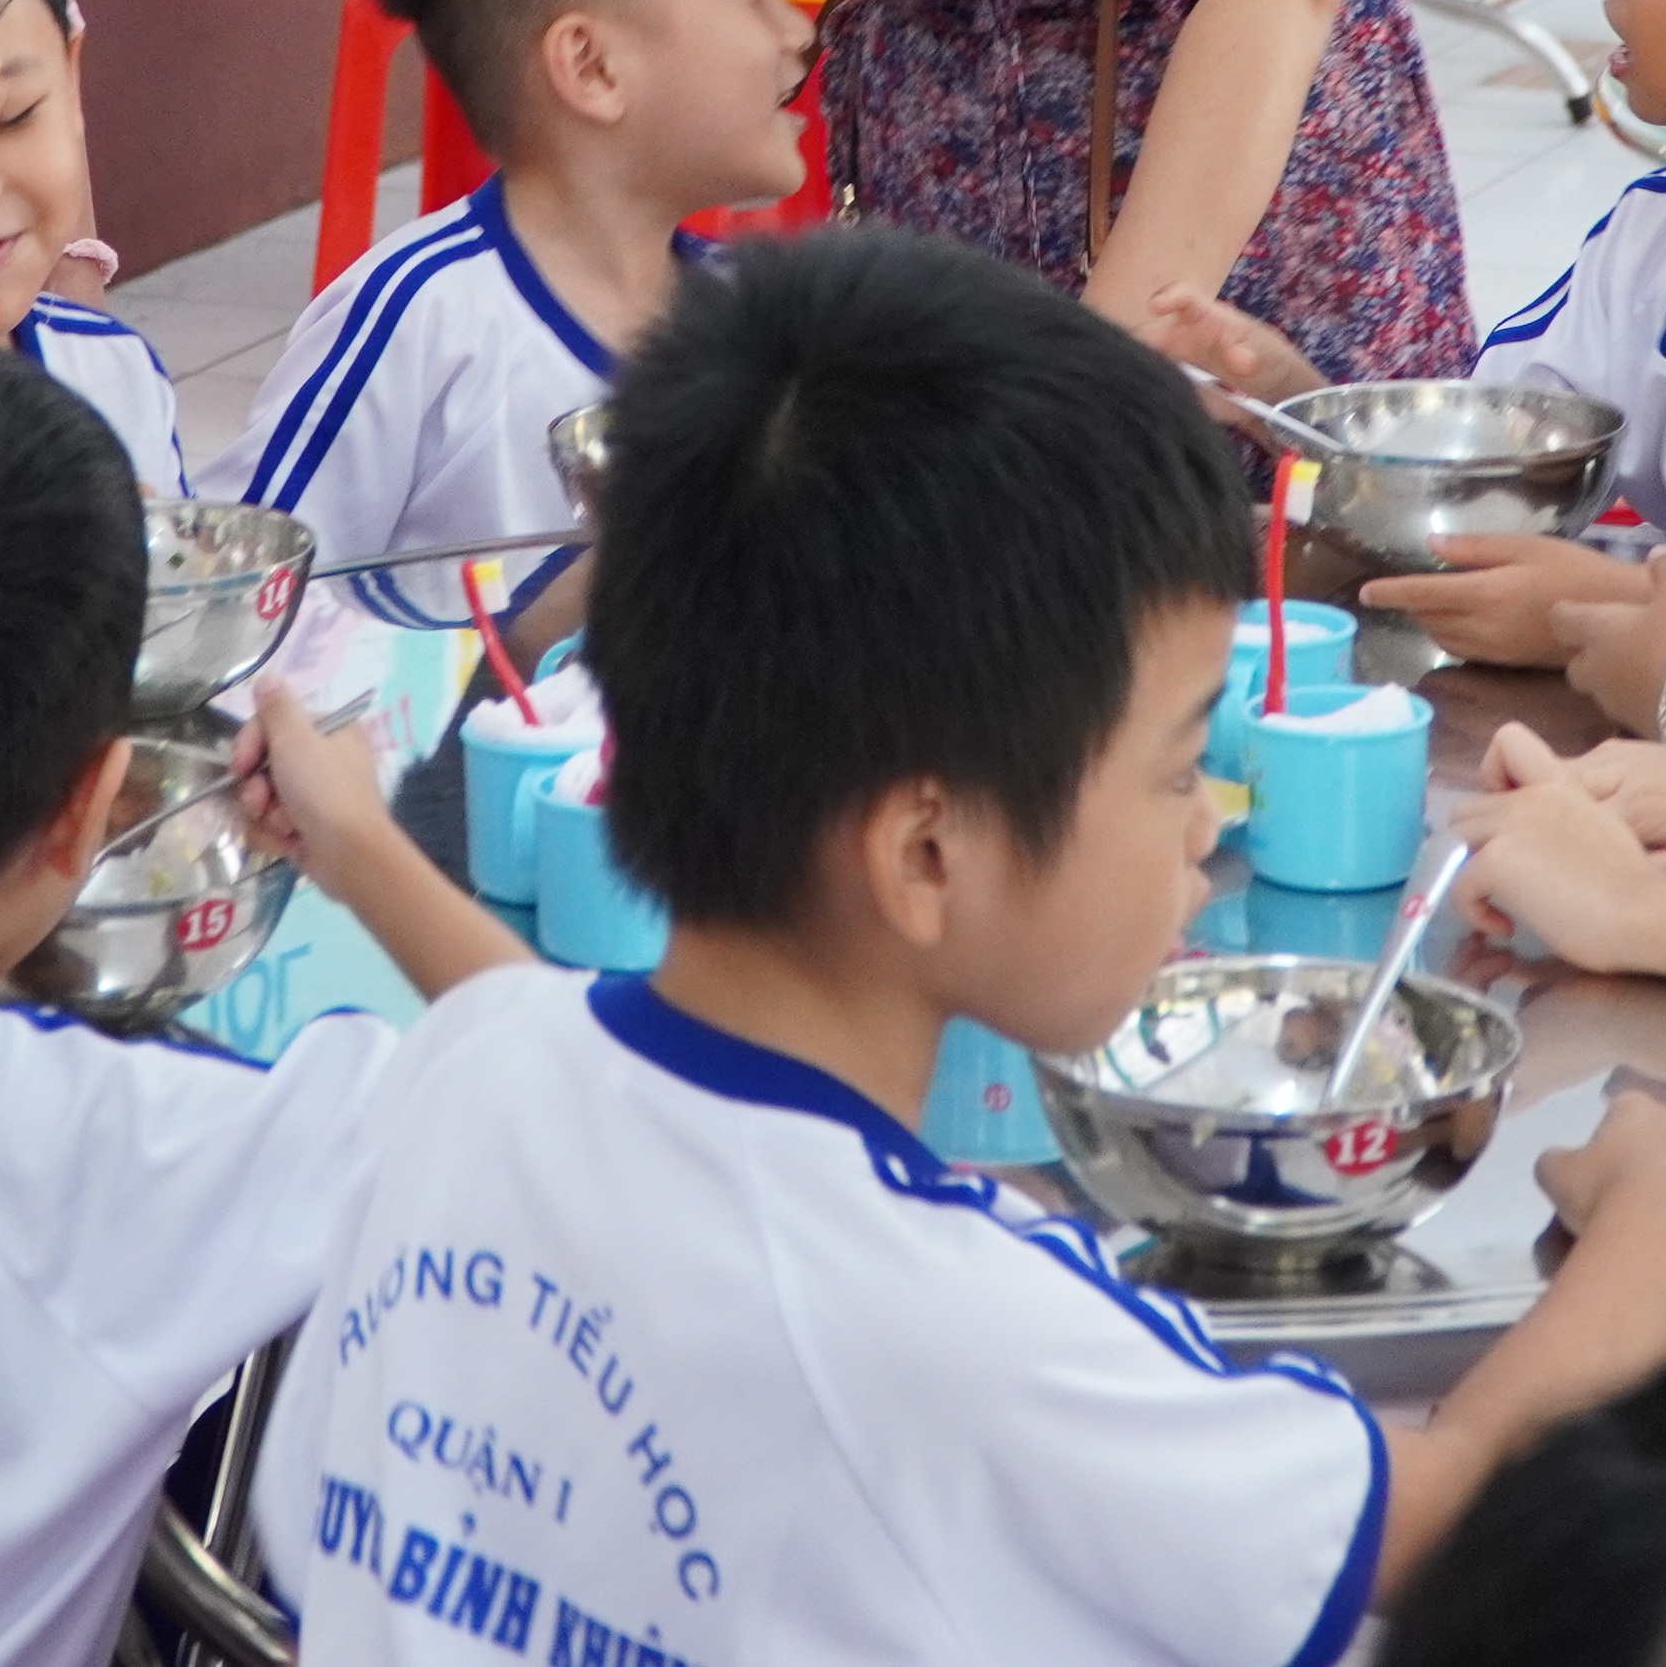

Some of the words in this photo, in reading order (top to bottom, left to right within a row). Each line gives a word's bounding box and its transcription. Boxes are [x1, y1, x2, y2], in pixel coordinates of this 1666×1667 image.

[260, 574, 293, 614] 14
[183, 903, 229, 944] 15
[1336, 1127, 1388, 1165] 12
[628, 1422, 721, 1602] HỌC
